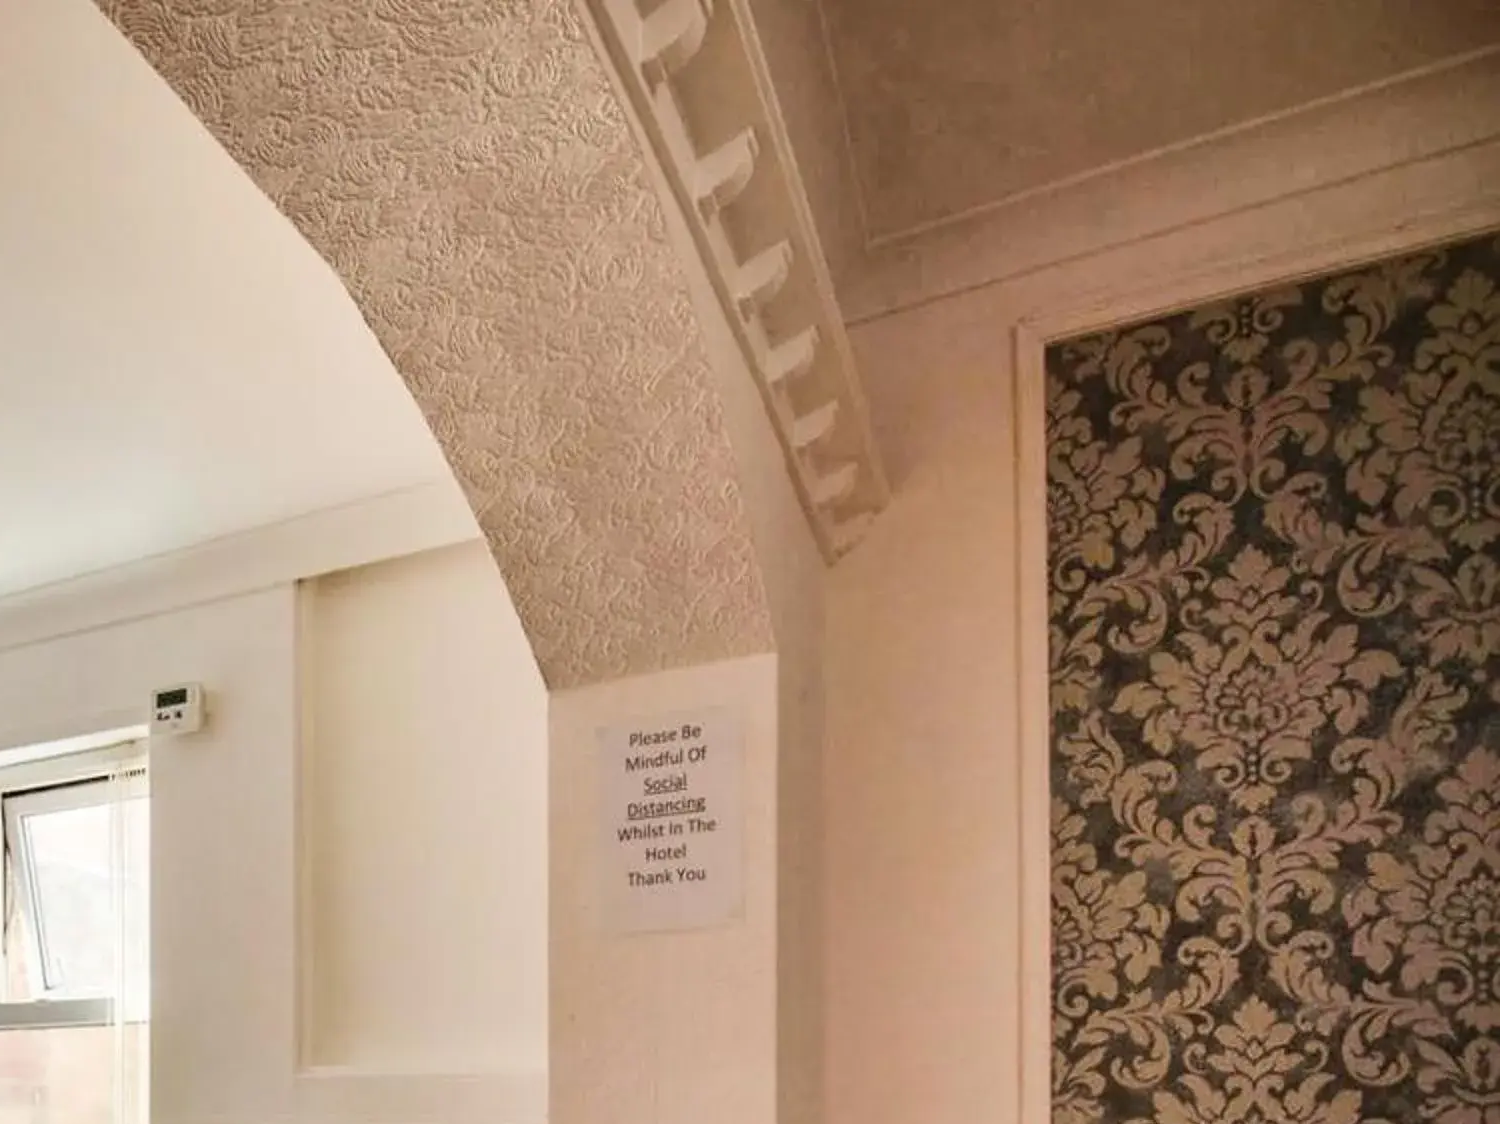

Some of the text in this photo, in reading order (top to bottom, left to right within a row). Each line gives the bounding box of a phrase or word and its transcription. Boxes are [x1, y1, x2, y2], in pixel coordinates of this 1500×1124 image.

[629, 725, 702, 748] Please Be
[625, 745, 708, 772] Mindful Of
[643, 773, 688, 794] Social
[627, 796, 706, 819] Distancing
[617, 818, 717, 842] Whilst In The
[645, 843, 687, 863] Hotel
[628, 867, 706, 888] Thank You
